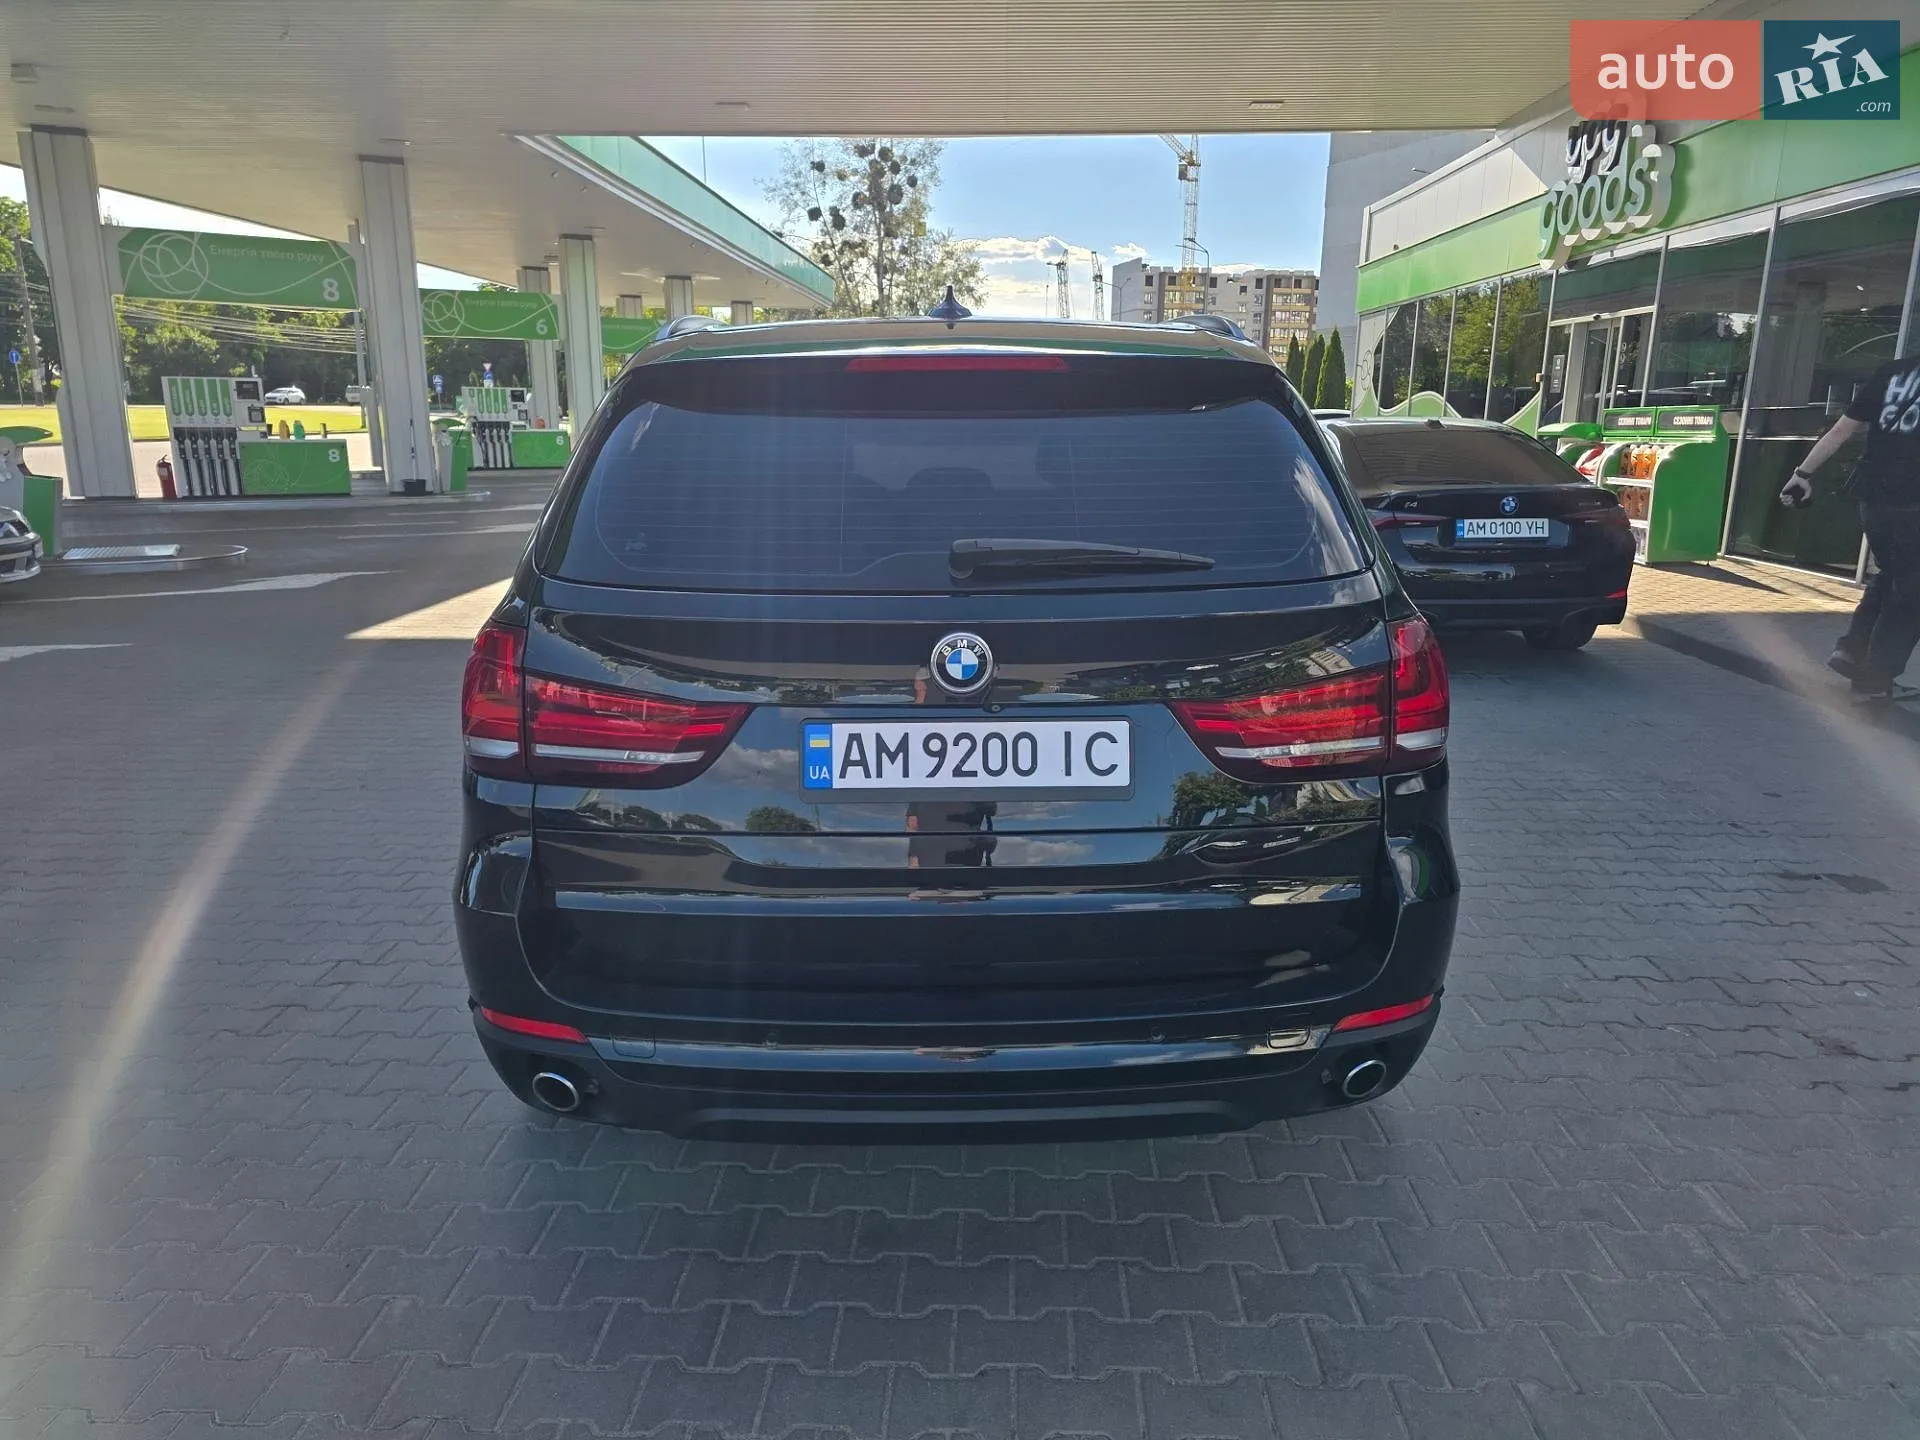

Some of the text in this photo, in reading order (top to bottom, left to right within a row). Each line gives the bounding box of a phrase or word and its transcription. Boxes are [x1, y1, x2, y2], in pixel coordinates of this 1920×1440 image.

[1537, 136, 1650, 259] goods
[210, 244, 325, 265] Енергія твого руху
[322, 278, 340, 302] 8
[535, 319, 548, 335] 6
[556, 436, 564, 445] 6
[328, 449, 340, 462] 8
[1466, 520, 1545, 536] AM 0100 YH
[941, 640, 984, 656] BMW
[839, 731, 1118, 779] AM 9200 IC
[809, 765, 831, 780] UA
